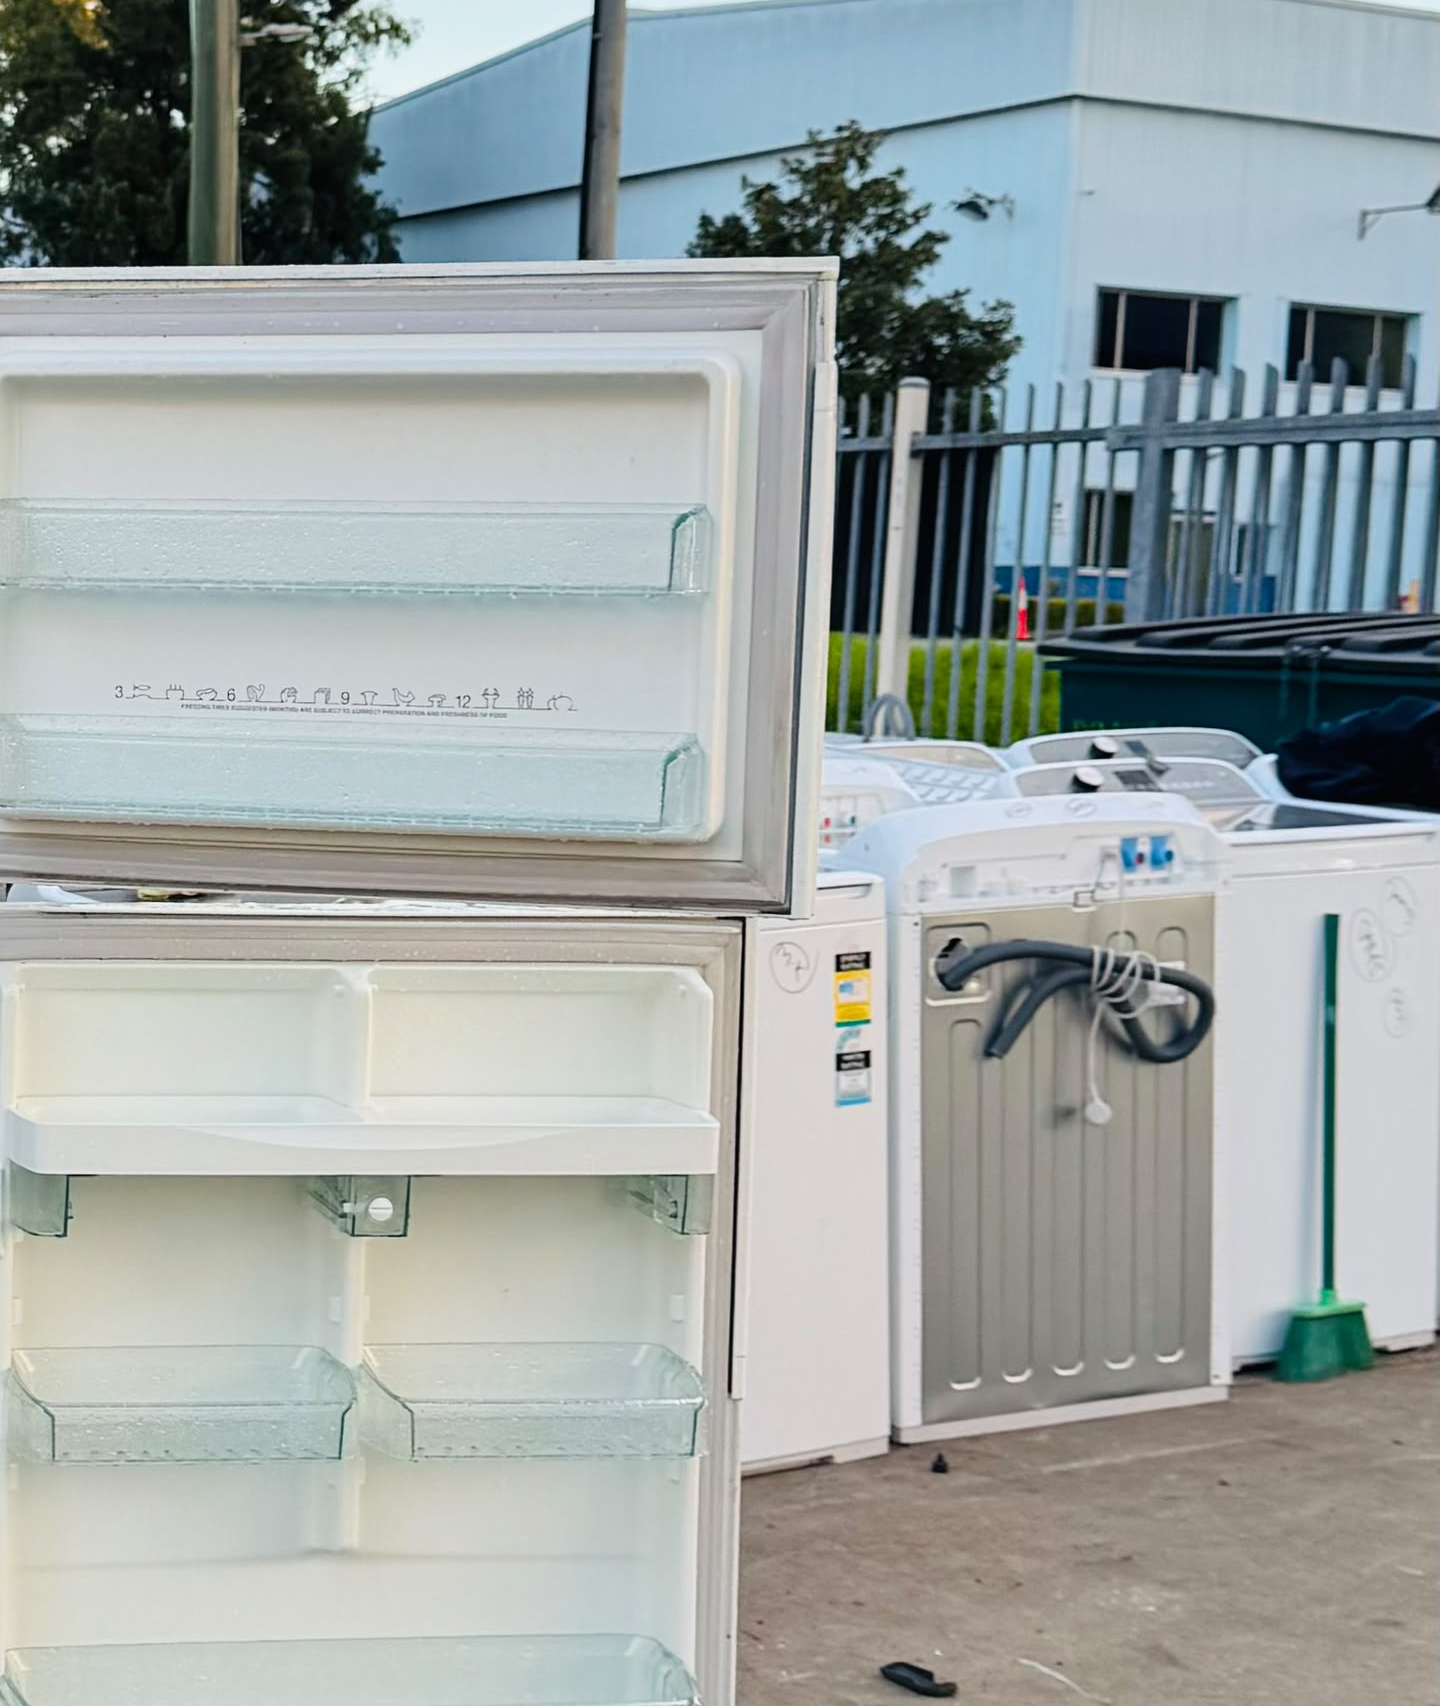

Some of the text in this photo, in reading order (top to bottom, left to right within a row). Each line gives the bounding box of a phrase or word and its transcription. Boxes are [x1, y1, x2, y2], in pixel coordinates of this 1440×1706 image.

[115, 685, 471, 709] 3 6 9 12
